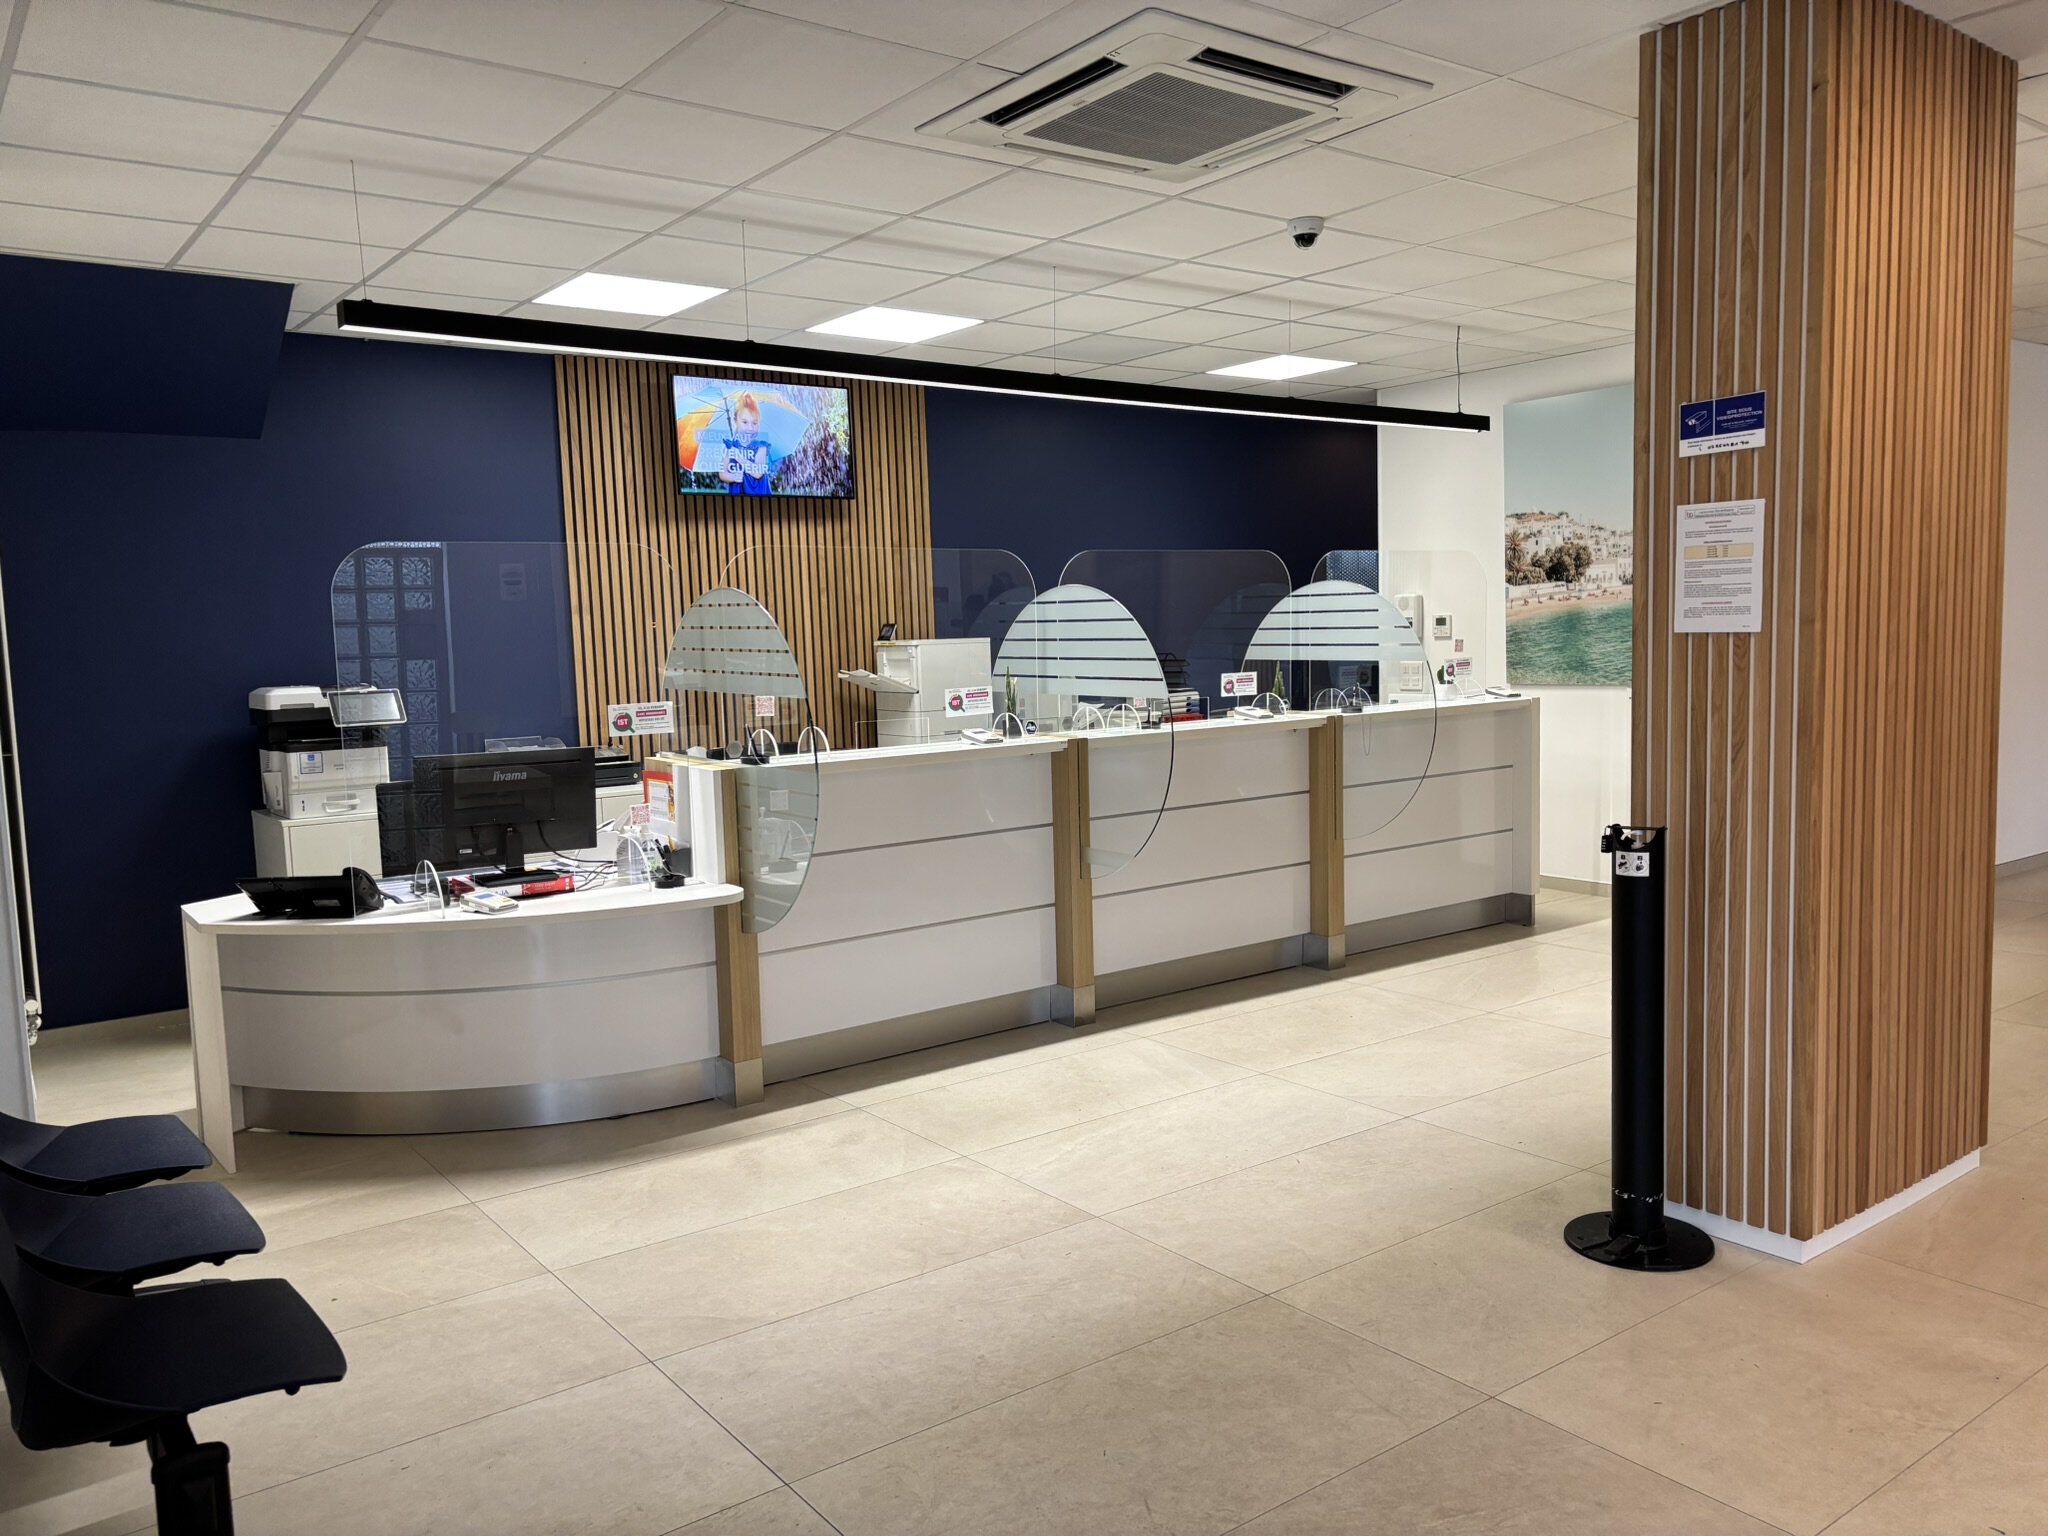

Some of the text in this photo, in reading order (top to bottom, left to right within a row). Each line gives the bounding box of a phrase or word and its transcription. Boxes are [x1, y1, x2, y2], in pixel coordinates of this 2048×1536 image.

[697, 431, 726, 441] MIEUX
[700, 461, 725, 473] QUE
[617, 718, 629, 726] IST
[493, 771, 527, 782] iiyama
